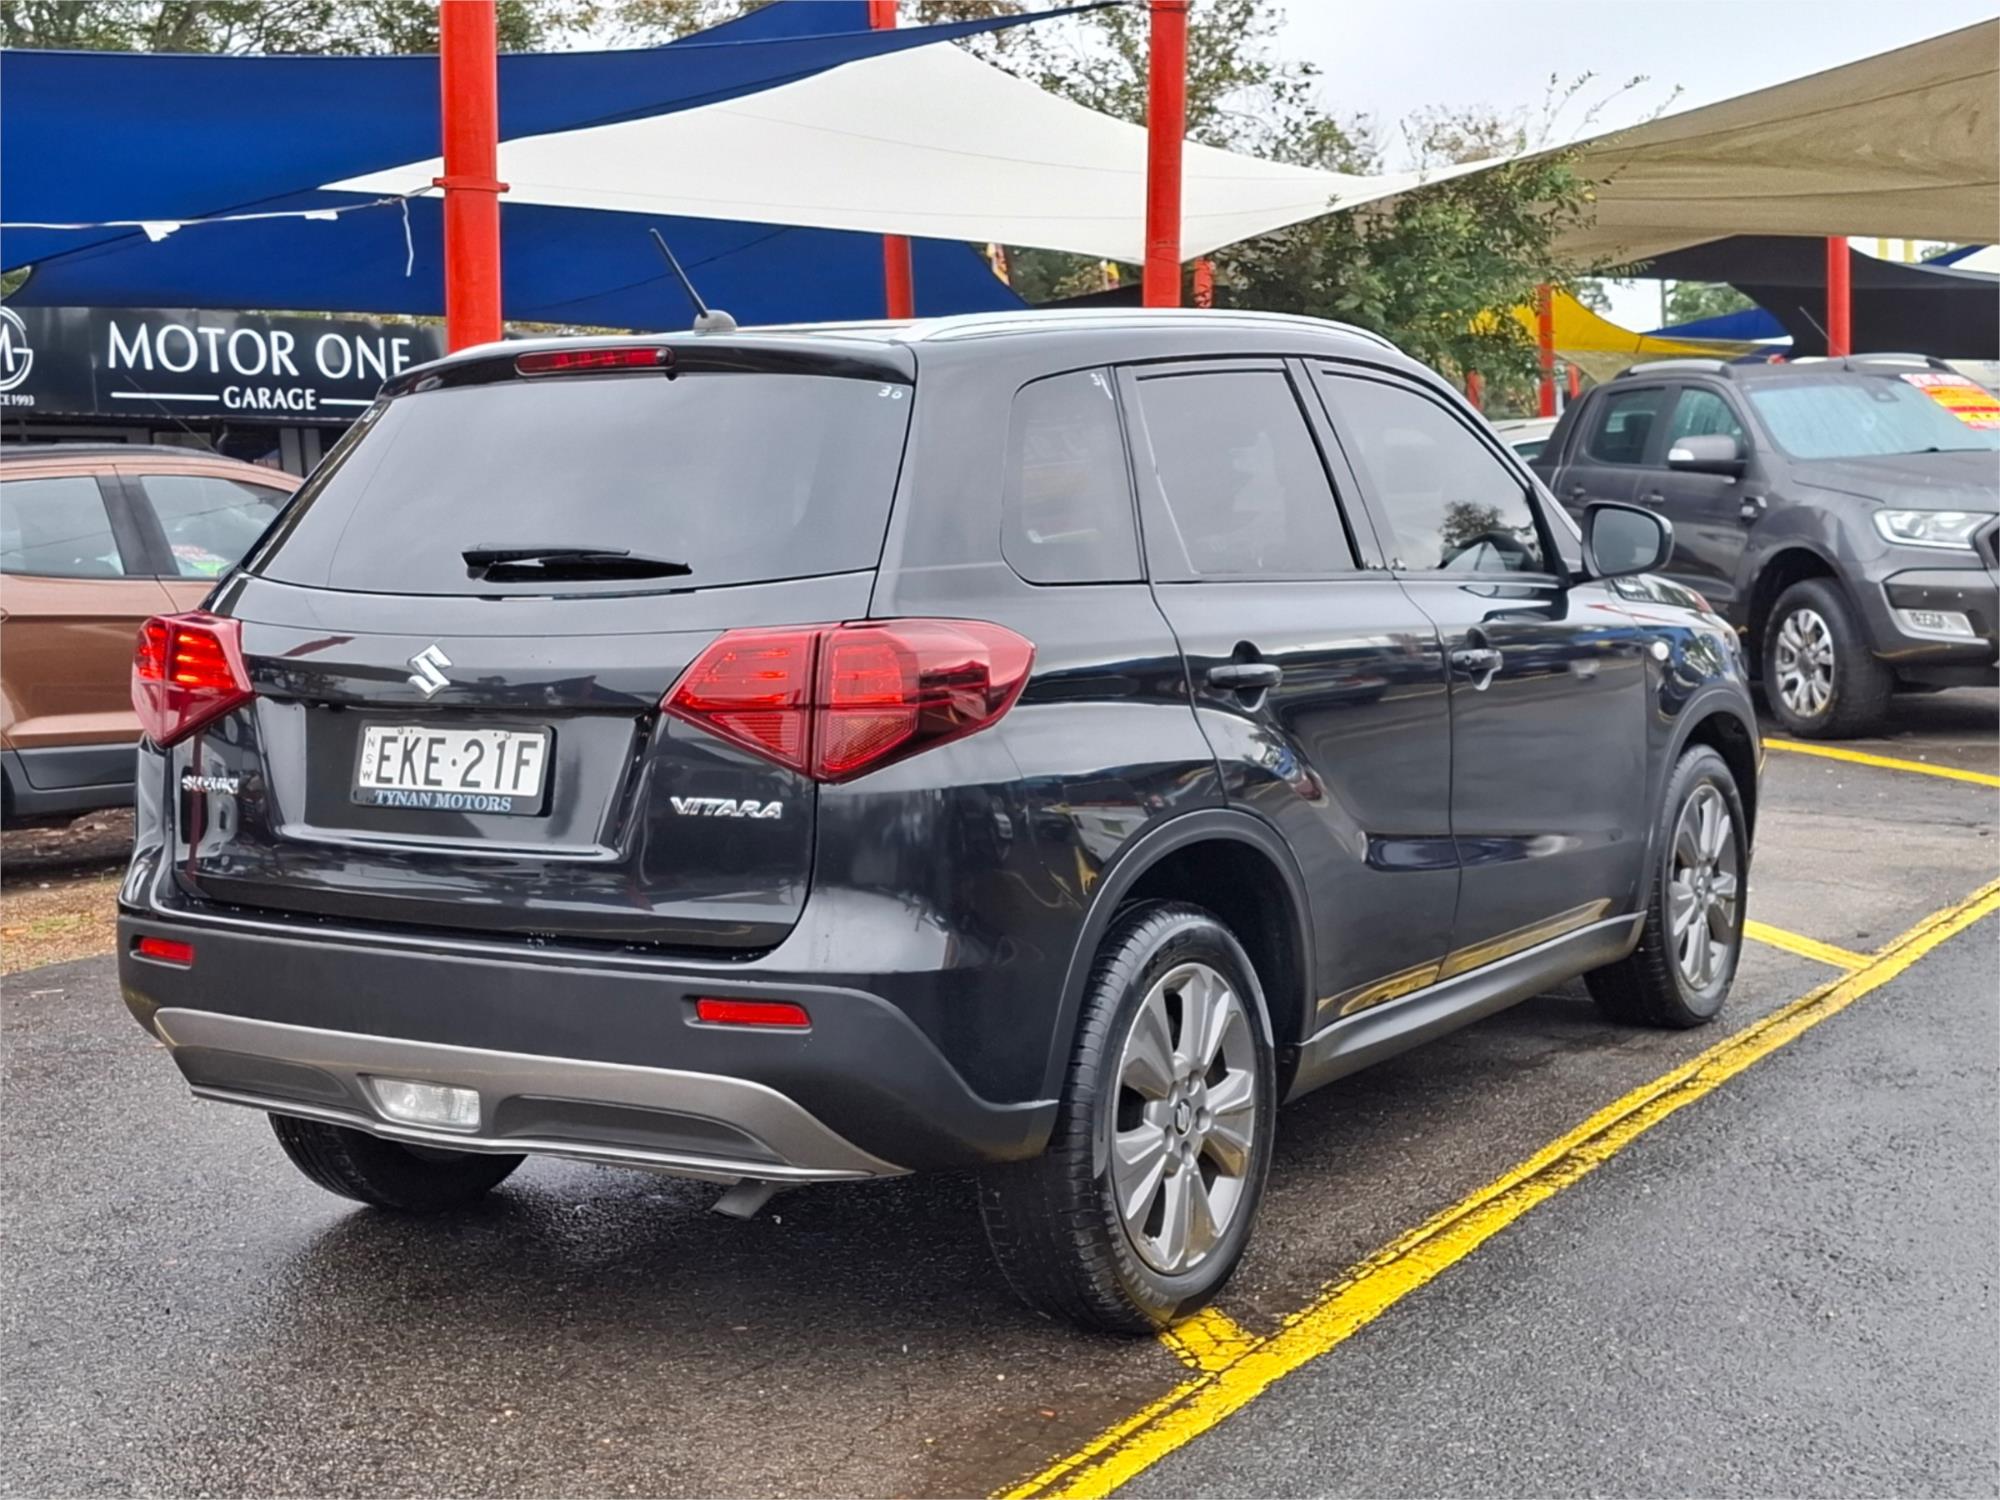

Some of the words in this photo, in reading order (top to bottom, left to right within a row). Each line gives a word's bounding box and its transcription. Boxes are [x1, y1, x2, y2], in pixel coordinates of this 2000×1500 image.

[108, 320, 299, 376] MOTOR
[223, 386, 316, 410] GARAGE
[373, 789, 435, 807] TYNAN
[435, 791, 513, 812] MOTORS
[670, 796, 783, 819] VITARA
